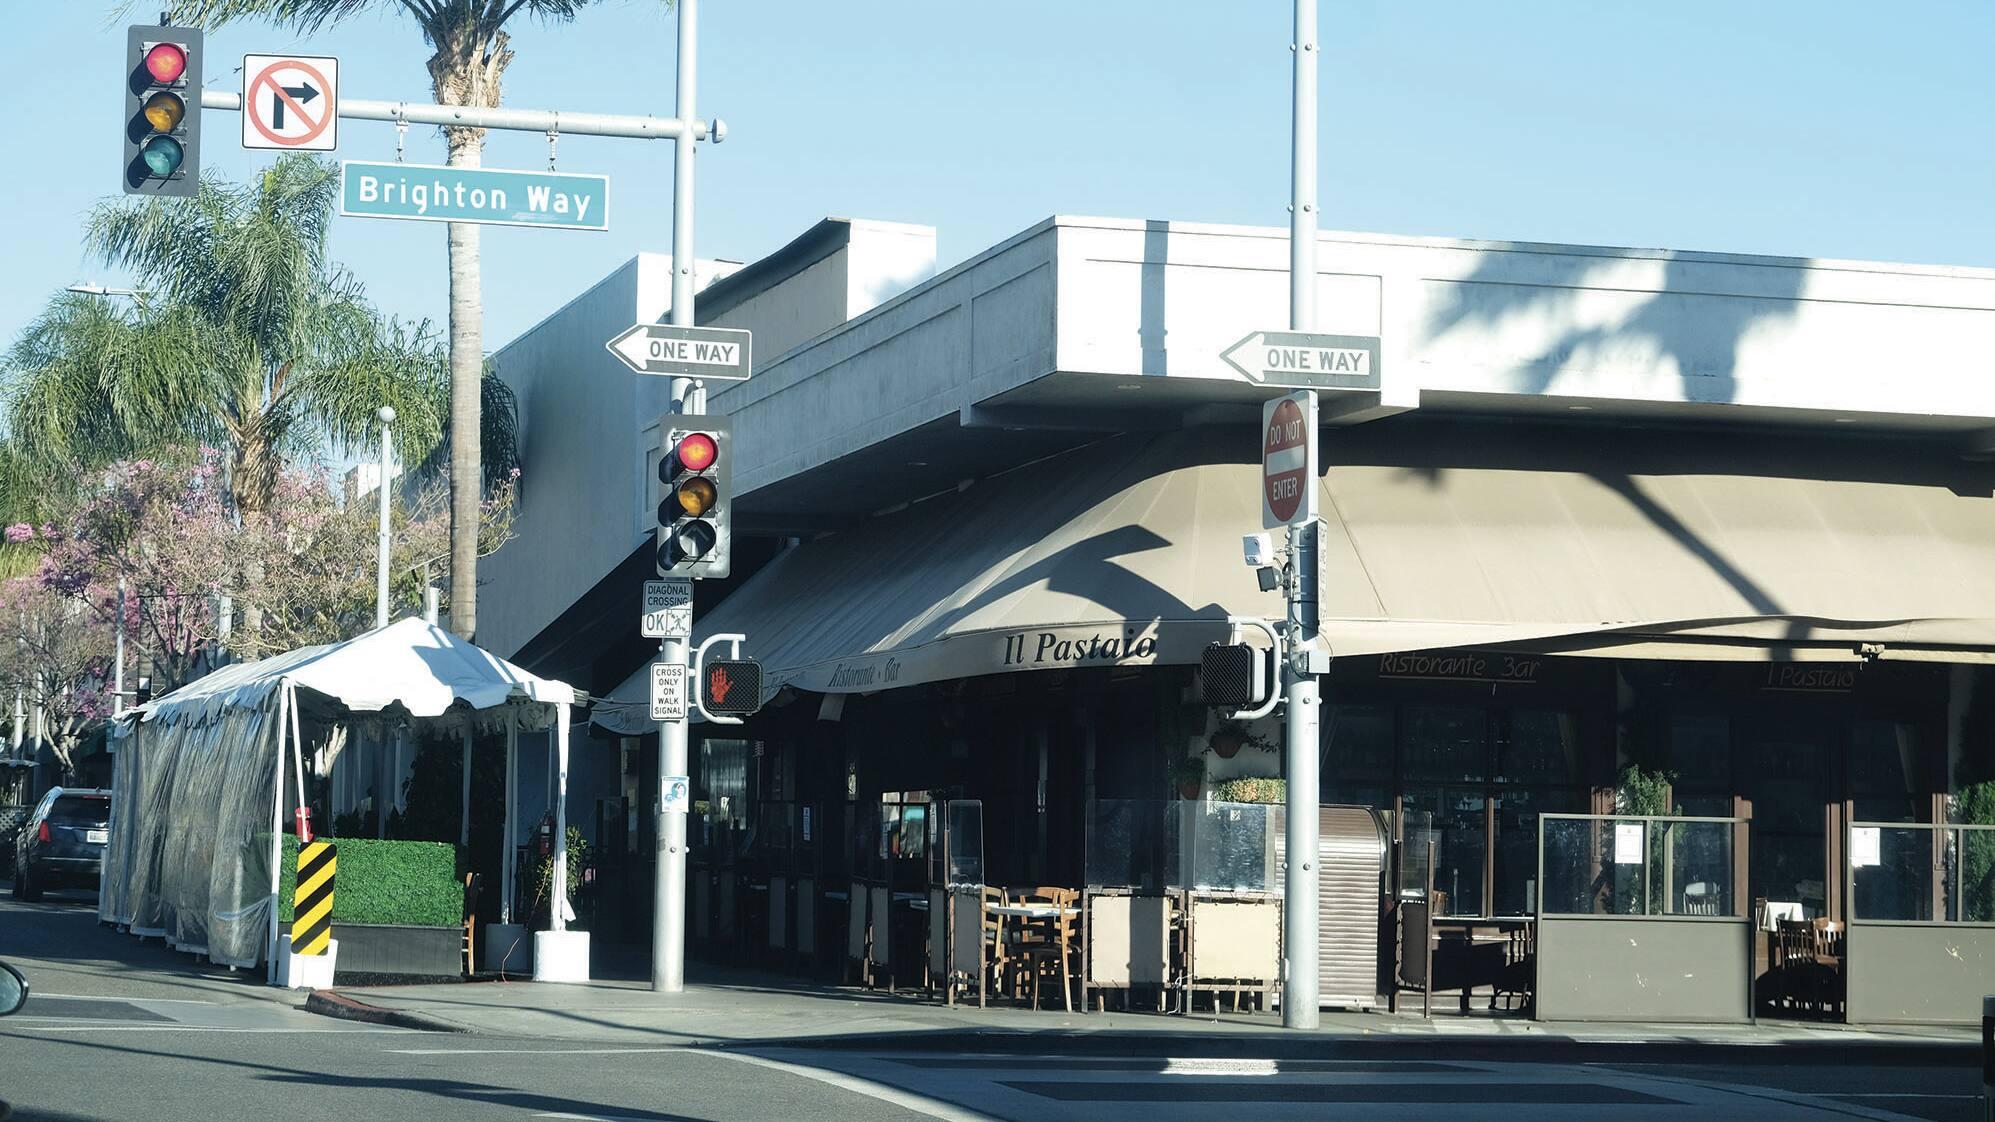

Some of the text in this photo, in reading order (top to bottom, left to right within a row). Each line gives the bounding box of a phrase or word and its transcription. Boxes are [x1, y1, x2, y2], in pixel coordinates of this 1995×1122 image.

[359, 175, 591, 221] Brighton Way
[650, 340, 734, 362] ONE WAY
[1267, 348, 1363, 372] ONE WAY
[1270, 419, 1301, 445] DO NOT
[1273, 476, 1298, 501] ENTER
[647, 584, 689, 596] DIAGONAL
[647, 596, 688, 607] CROSSING
[646, 613, 665, 631] OK
[1003, 628, 1157, 665] Il Pastaio
[655, 668, 682, 676] CROSS
[1379, 651, 1487, 677] Ristorante
[658, 678, 679, 686] ONLY
[1779, 663, 1854, 688] Pastaio
[657, 697, 679, 705] WALK
[663, 687, 675, 696] ON
[654, 706, 682, 715] SIGNAL
